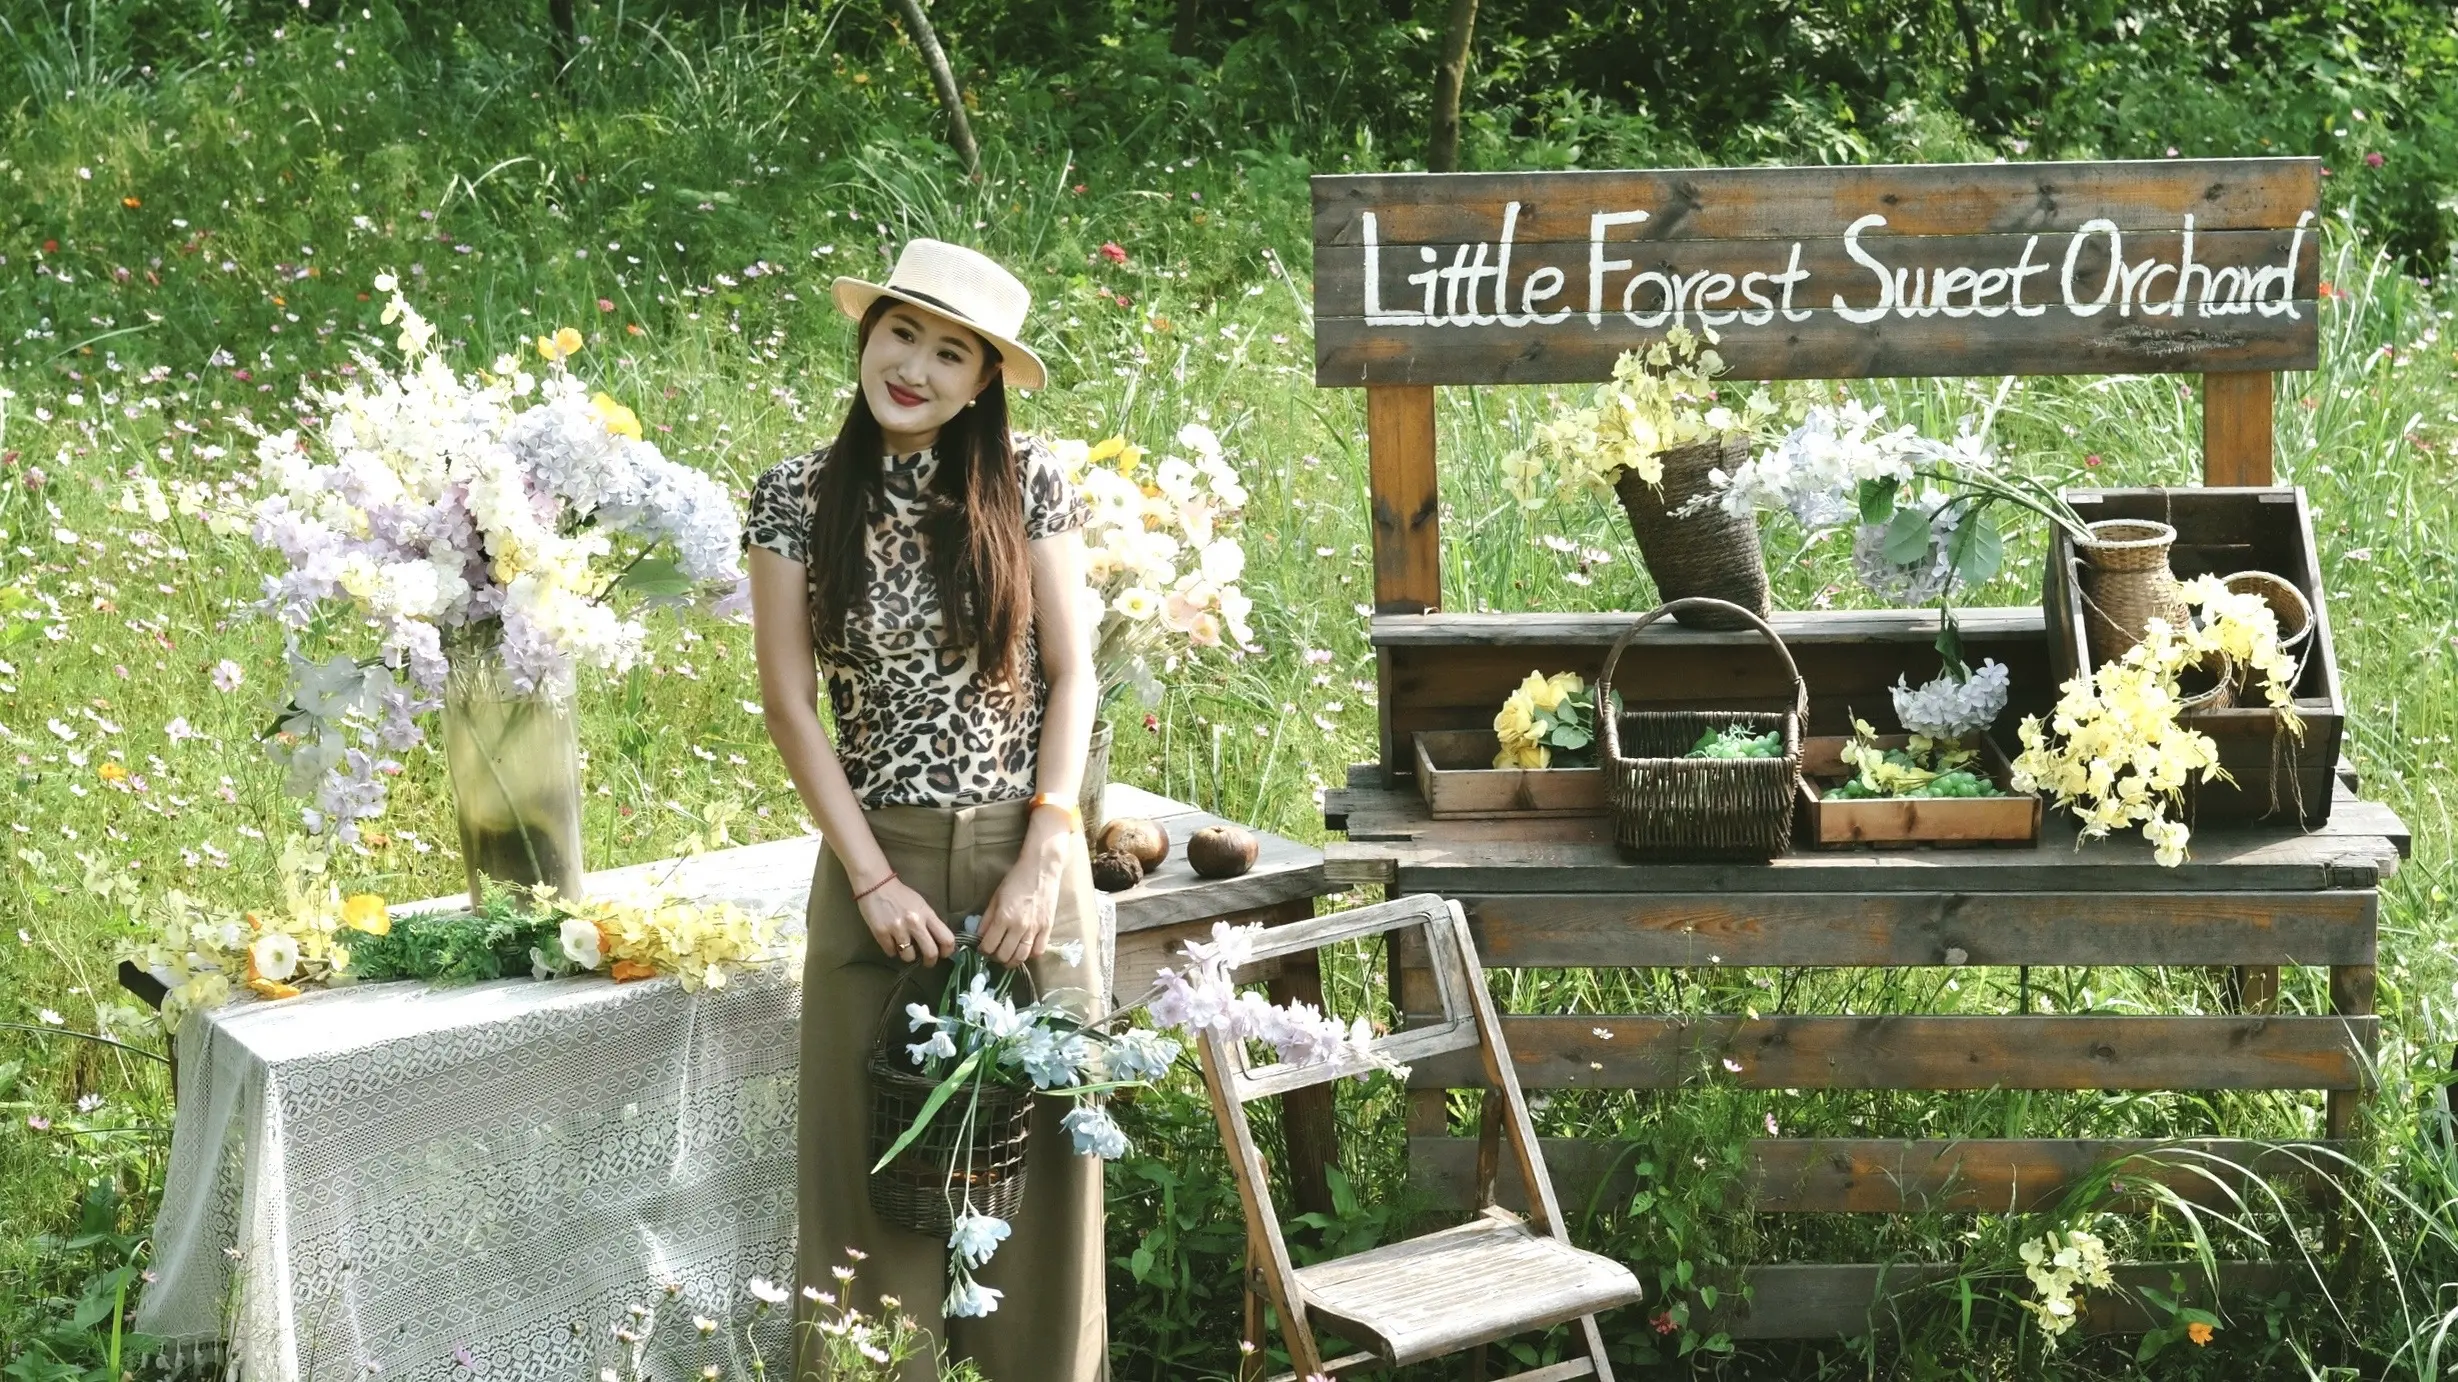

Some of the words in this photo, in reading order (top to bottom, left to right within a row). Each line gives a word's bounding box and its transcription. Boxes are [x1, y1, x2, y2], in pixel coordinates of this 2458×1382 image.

[1362, 201, 1572, 328] Little
[1587, 209, 1812, 330] Forest
[1833, 213, 2050, 323] Sweet
[2061, 210, 2315, 319] Orchard
